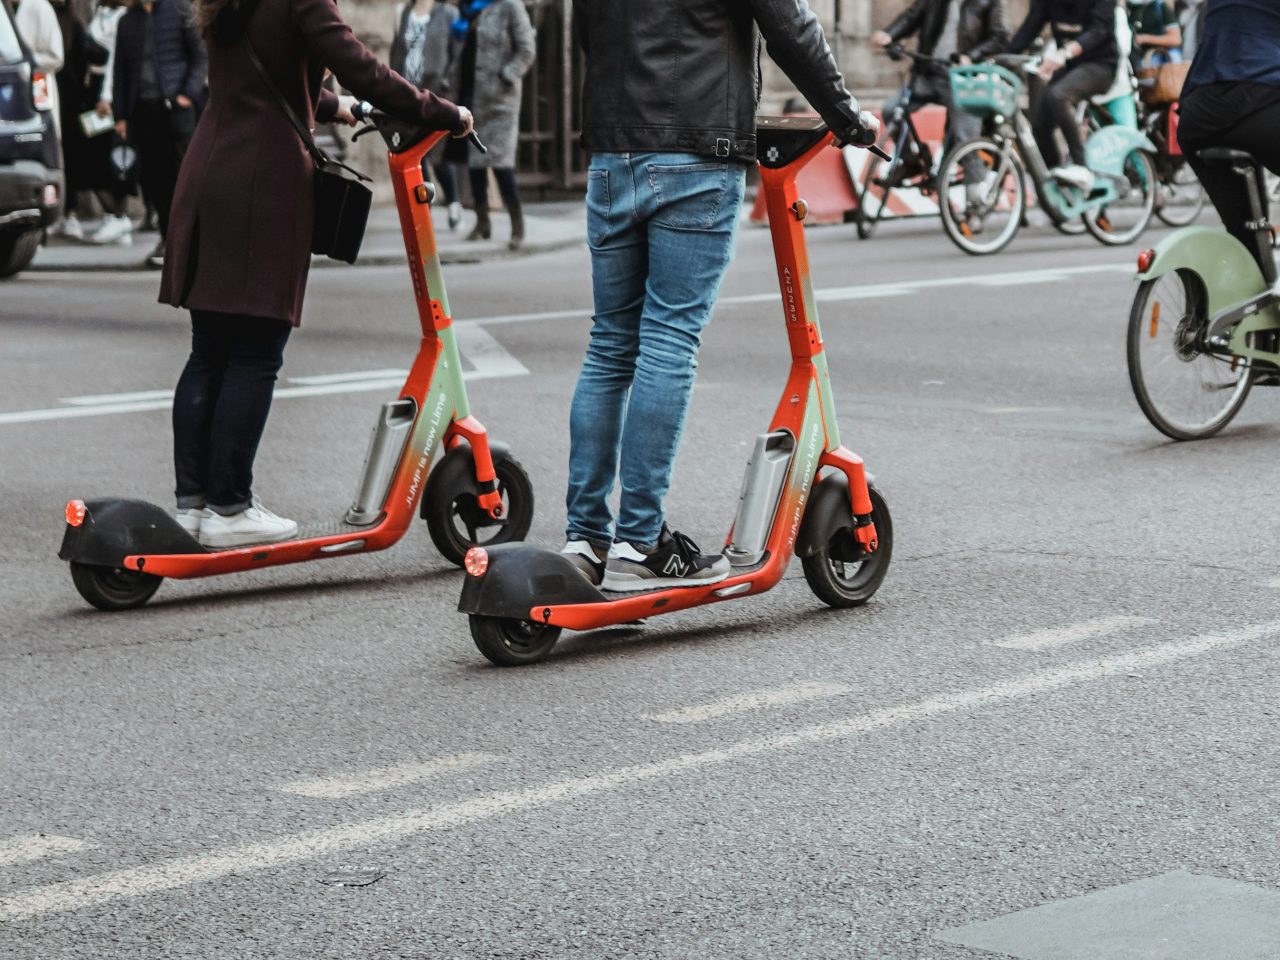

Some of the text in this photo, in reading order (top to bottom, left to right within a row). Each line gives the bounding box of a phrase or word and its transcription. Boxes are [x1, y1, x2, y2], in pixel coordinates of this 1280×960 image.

[406, 393, 447, 505] JUMP is now Lime
[788, 423, 819, 545] JUMP is now Lime
